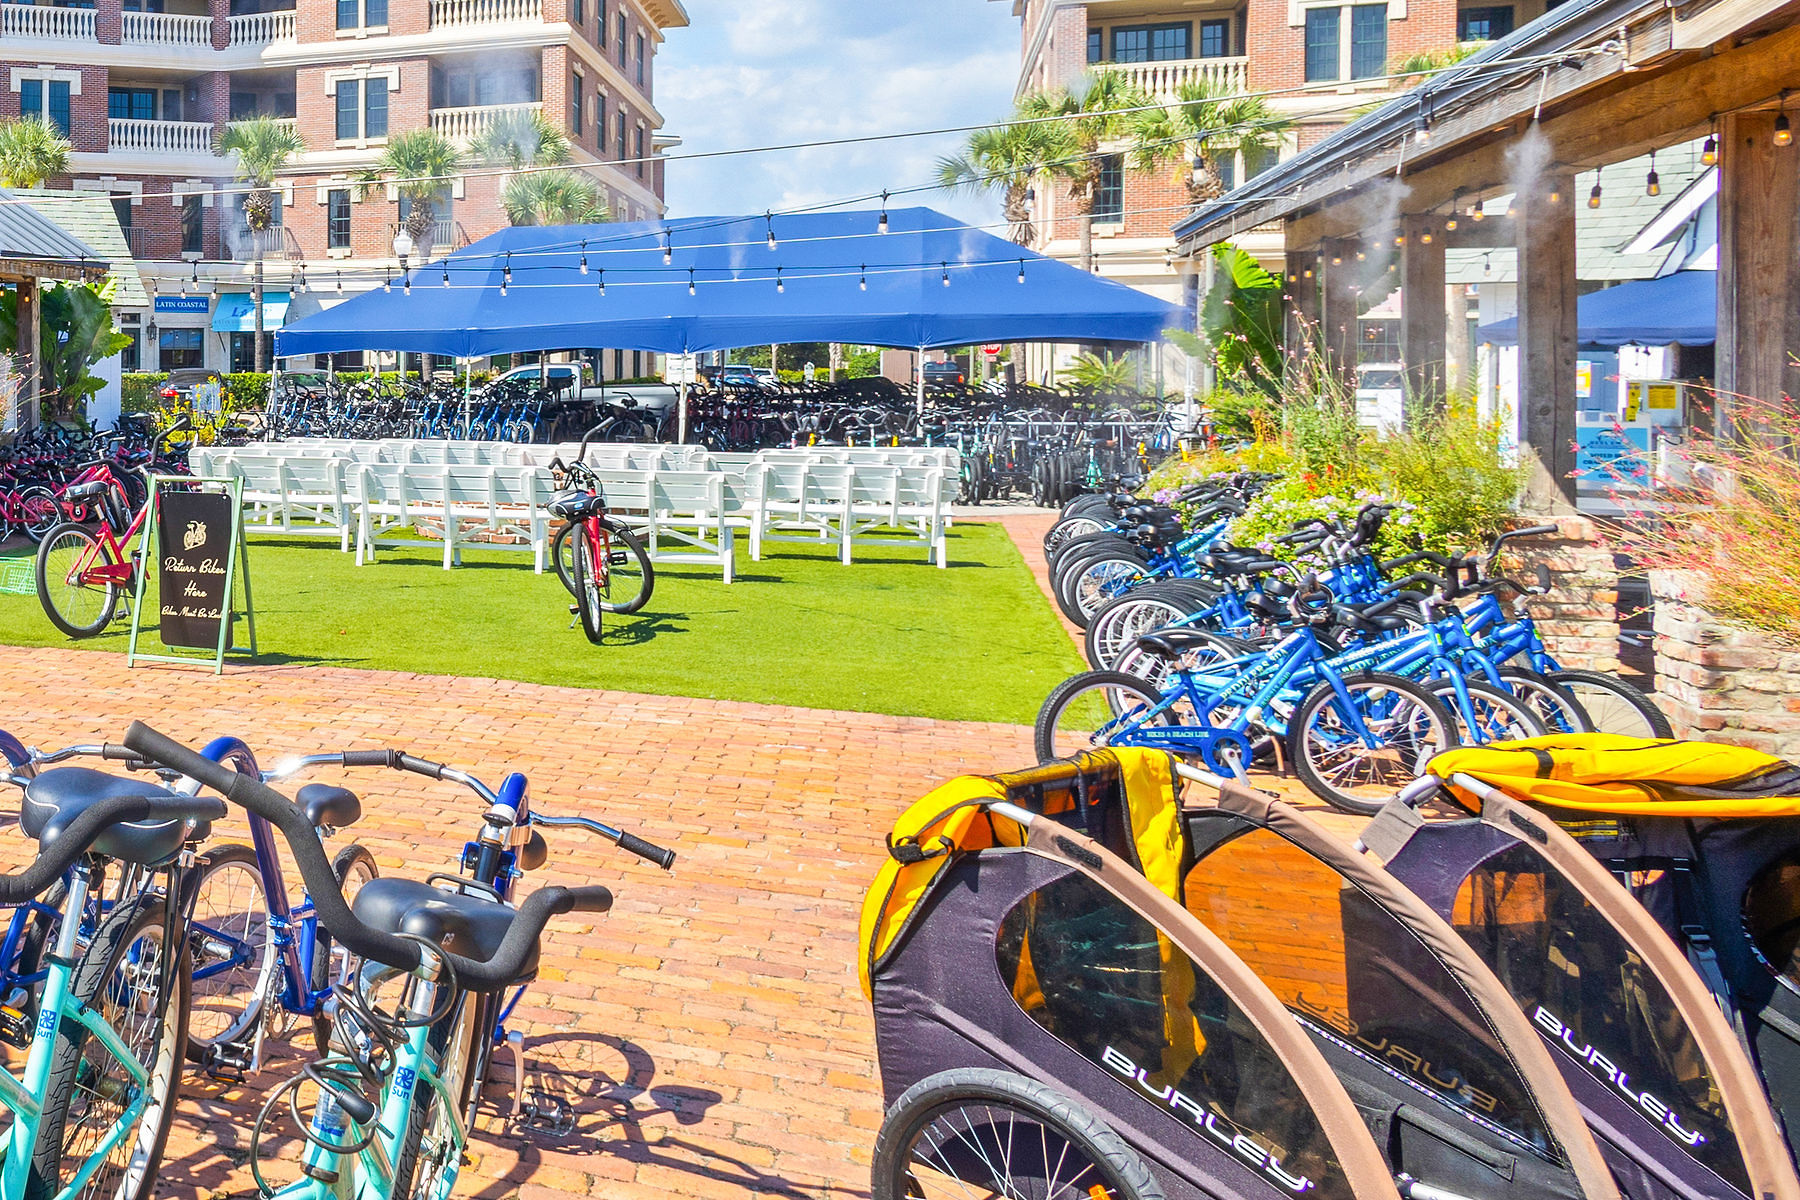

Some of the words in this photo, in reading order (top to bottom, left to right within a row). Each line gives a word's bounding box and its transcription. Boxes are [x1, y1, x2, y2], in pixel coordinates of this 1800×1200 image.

[164, 556, 196, 573] Return
[199, 558, 226, 574] Bikes
[184, 580, 208, 597] Here
[36, 1027, 53, 1039] Sun
[1534, 1005, 1707, 1147] BURLEY
[391, 1085, 410, 1100] Sun
[1102, 1045, 1313, 1192] BURLEY
